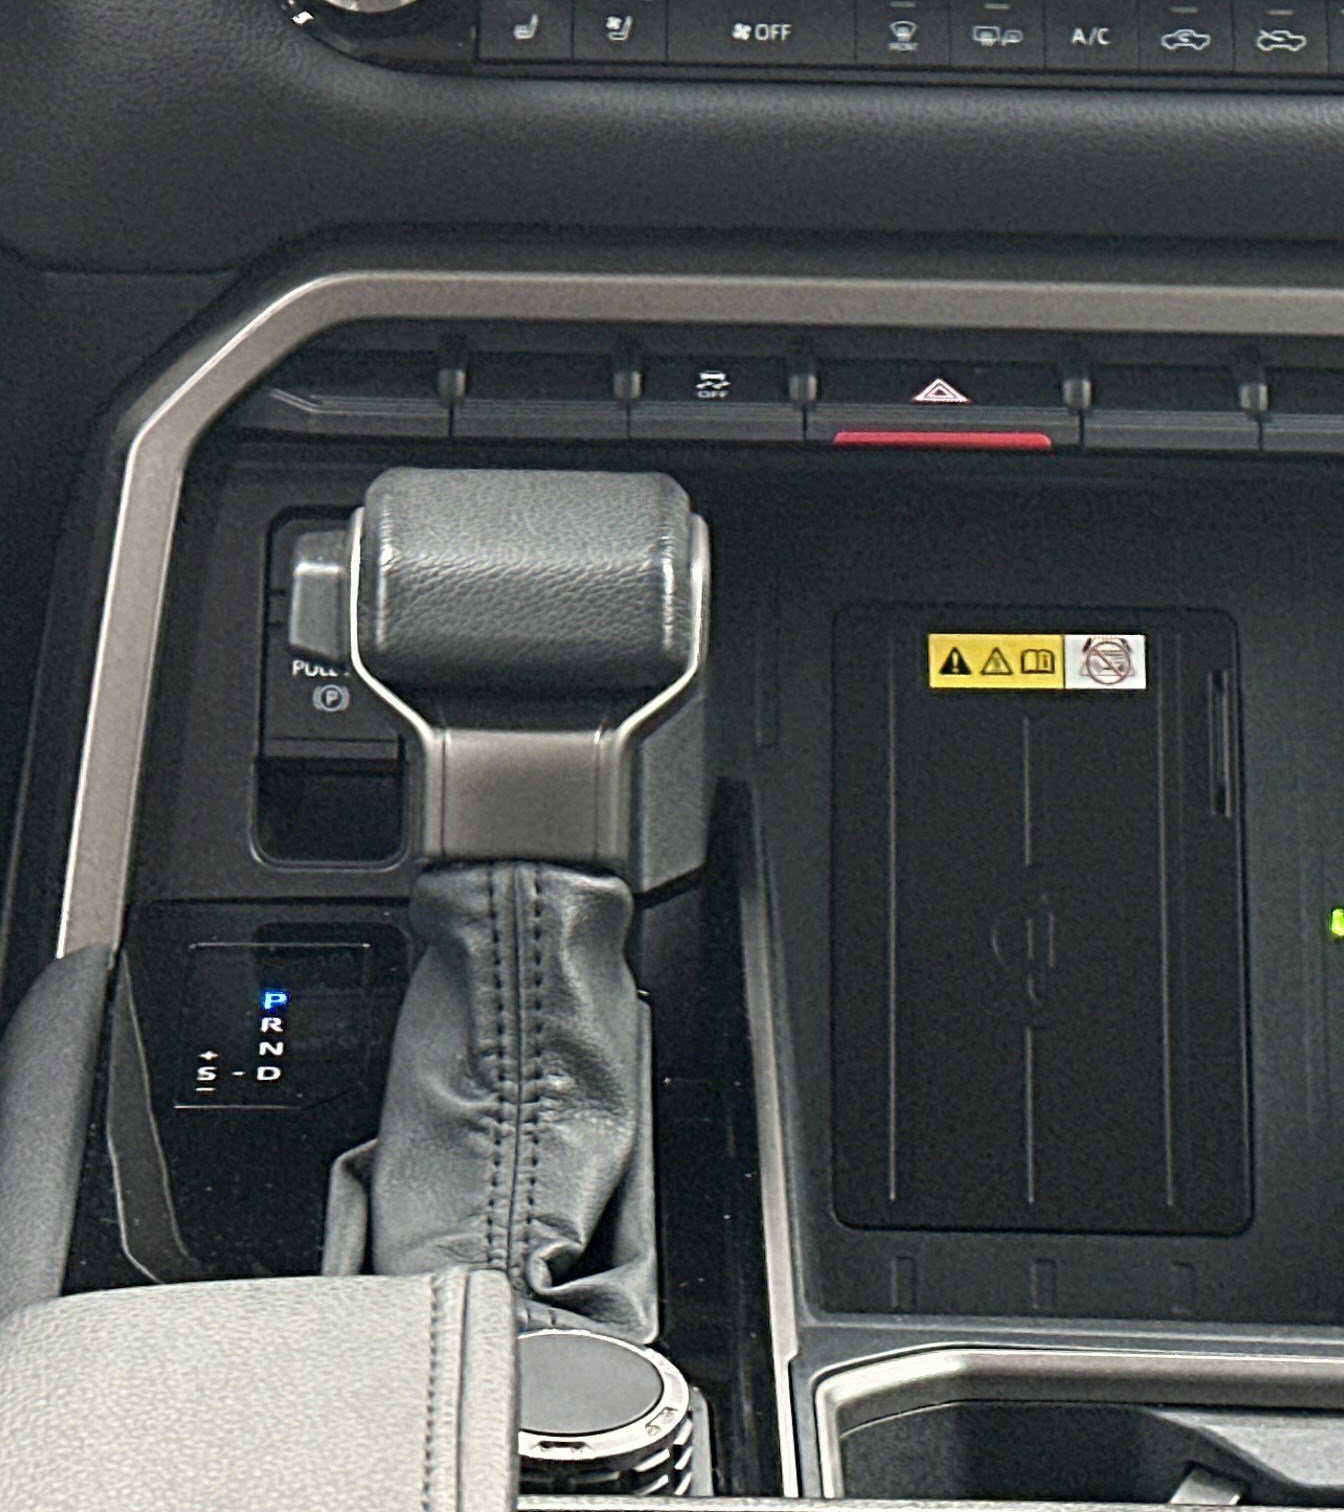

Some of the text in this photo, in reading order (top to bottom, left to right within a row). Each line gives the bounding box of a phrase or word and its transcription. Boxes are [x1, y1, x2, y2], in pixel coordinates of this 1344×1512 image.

[755, 23, 792, 41] OFF
[1070, 27, 1110, 46] A/C
[263, 991, 288, 1010] P
[261, 1017, 284, 1033] R
[259, 1041, 284, 1057] N
[196, 1066, 217, 1081] S
[256, 1066, 281, 1081] D
